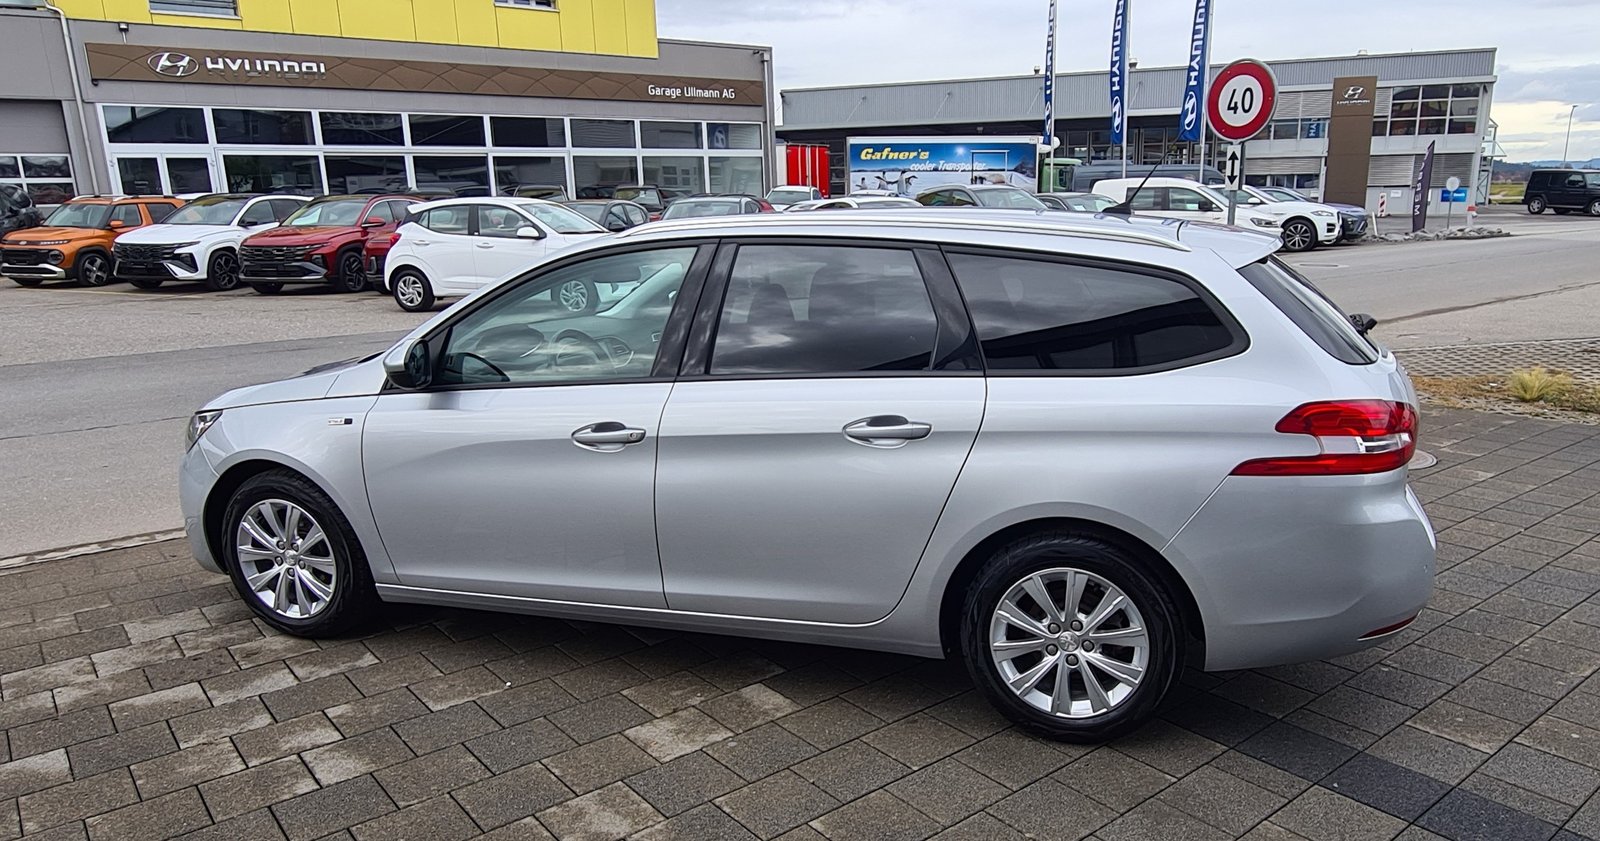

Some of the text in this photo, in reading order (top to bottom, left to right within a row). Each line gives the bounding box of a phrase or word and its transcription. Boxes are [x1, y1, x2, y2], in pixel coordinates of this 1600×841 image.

[205, 56, 326, 79] HYUNDAI
[648, 84, 735, 99] Garage Ullmann AG
[1227, 87, 1254, 115] 40
[860, 147, 930, 160] Gafner's
[909, 160, 937, 171] cooler
